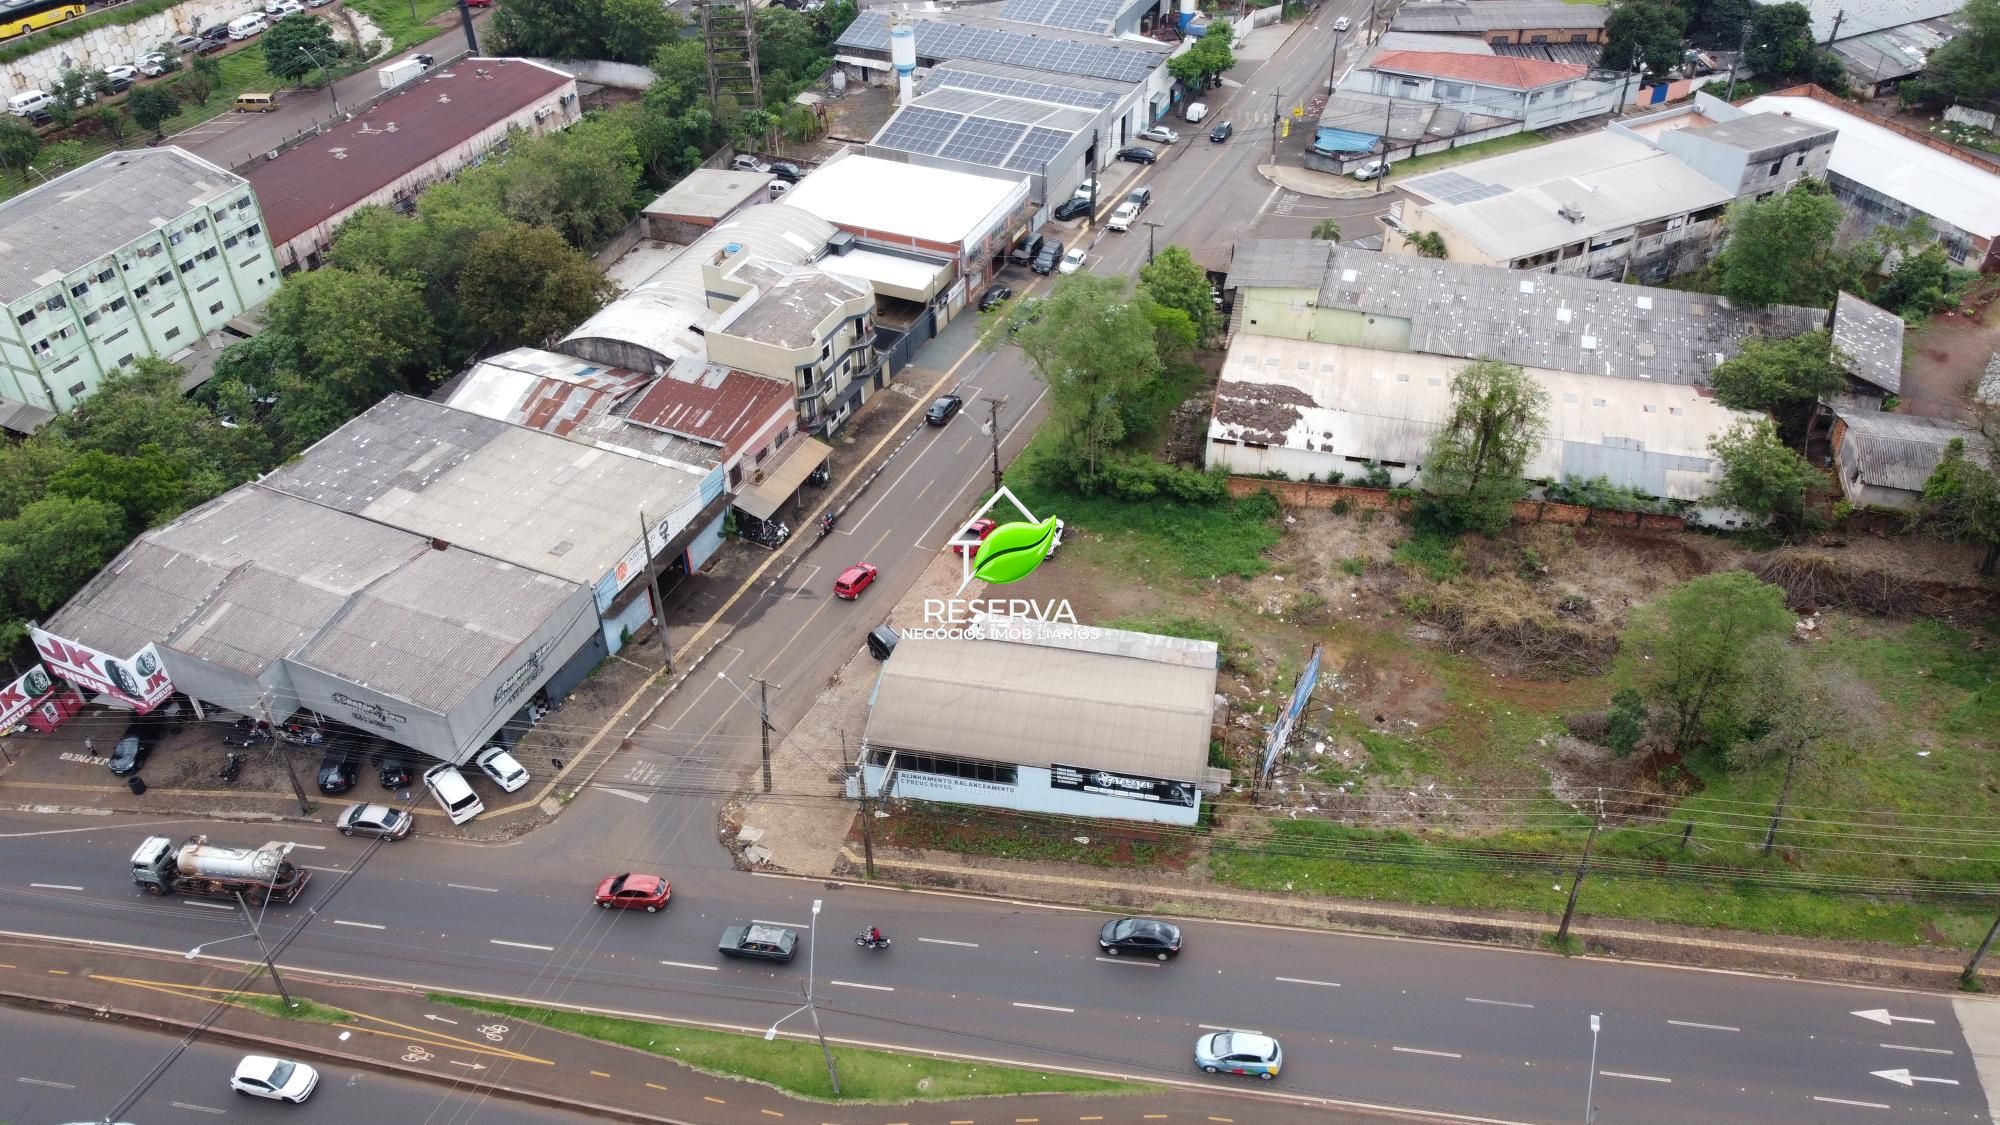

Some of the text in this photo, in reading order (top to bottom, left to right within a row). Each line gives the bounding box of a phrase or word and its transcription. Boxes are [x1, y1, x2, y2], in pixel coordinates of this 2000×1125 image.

[37, 637, 107, 679] JK
[51, 664, 110, 694] PNEUS
[144, 667, 168, 695] JK
[900, 773, 953, 785] ALINHAMENTO
